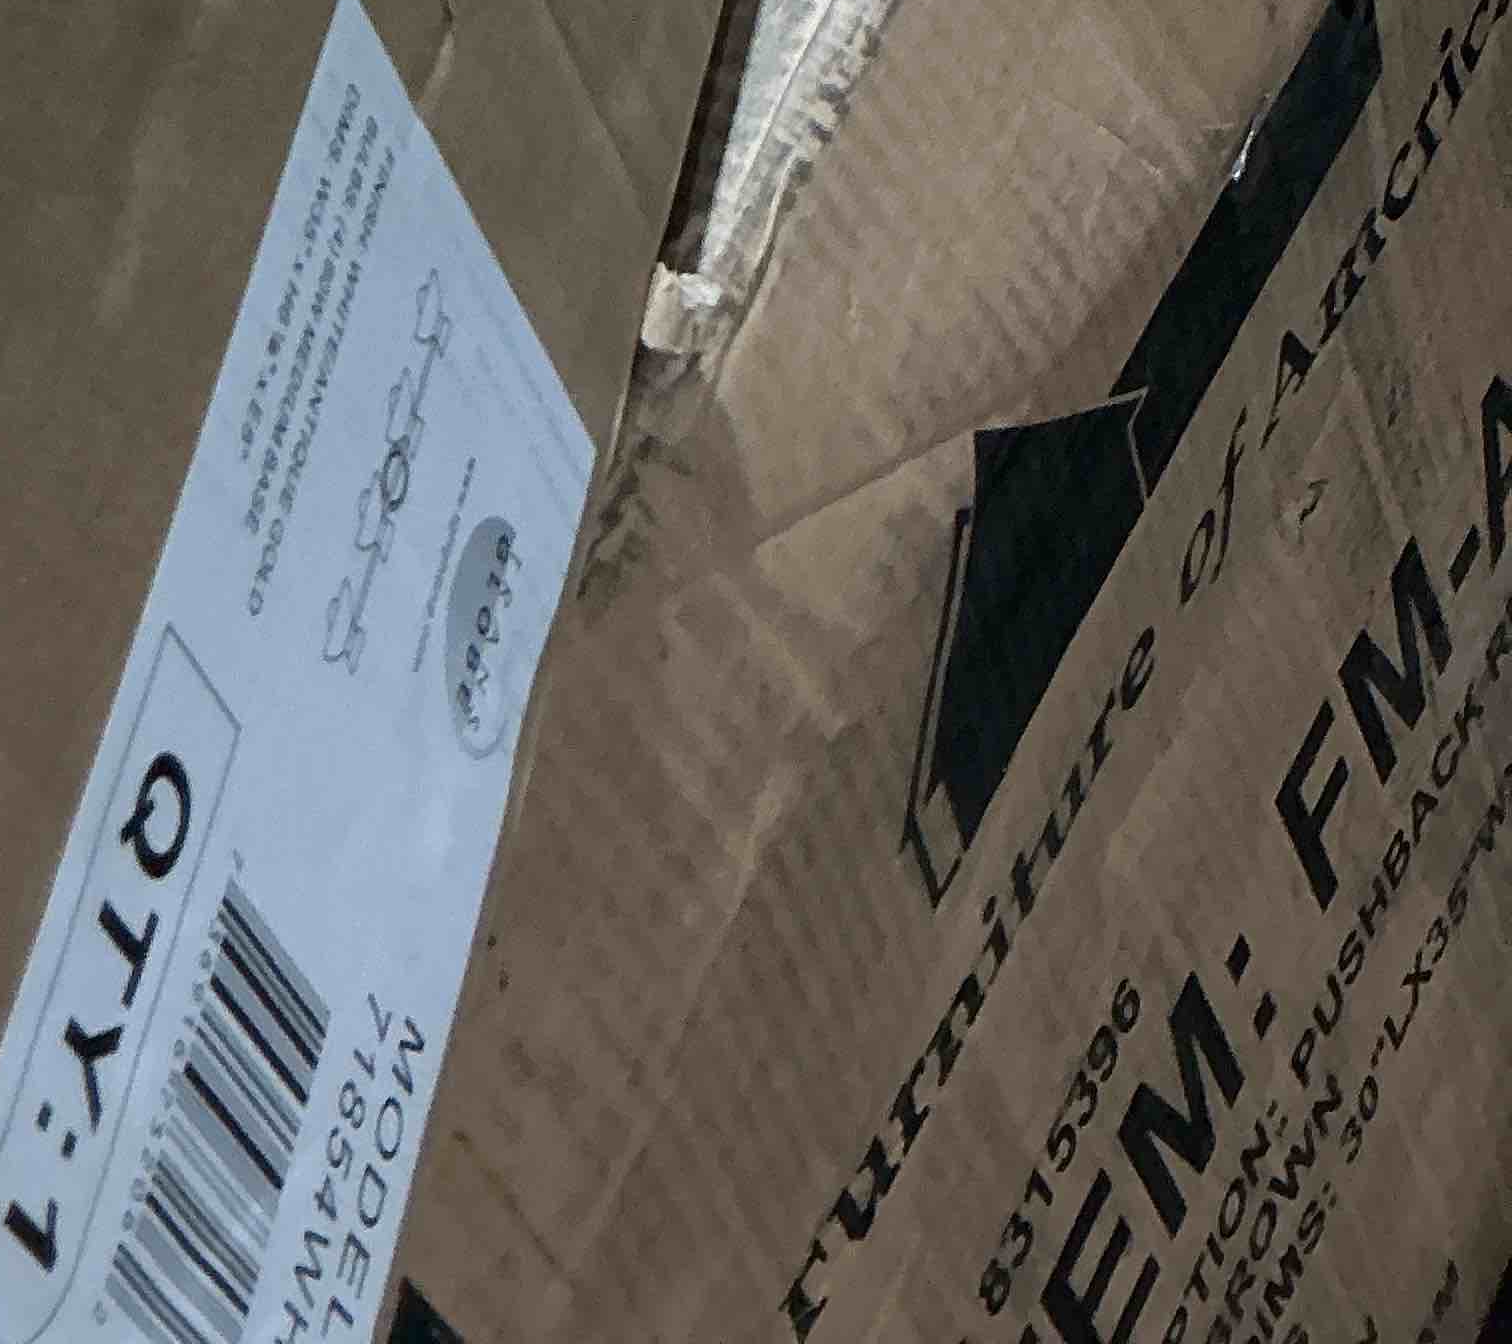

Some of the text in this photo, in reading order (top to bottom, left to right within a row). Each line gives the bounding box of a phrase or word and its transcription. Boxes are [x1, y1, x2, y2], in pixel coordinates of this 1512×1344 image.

[1179, 404, 1248, 606] of
[36, 750, 192, 1161] QTY:
[1289, 682, 1485, 1089] PUSHBACK
[3, 1198, 59, 1274] 1
[320, 1015, 426, 1338] MODEL
